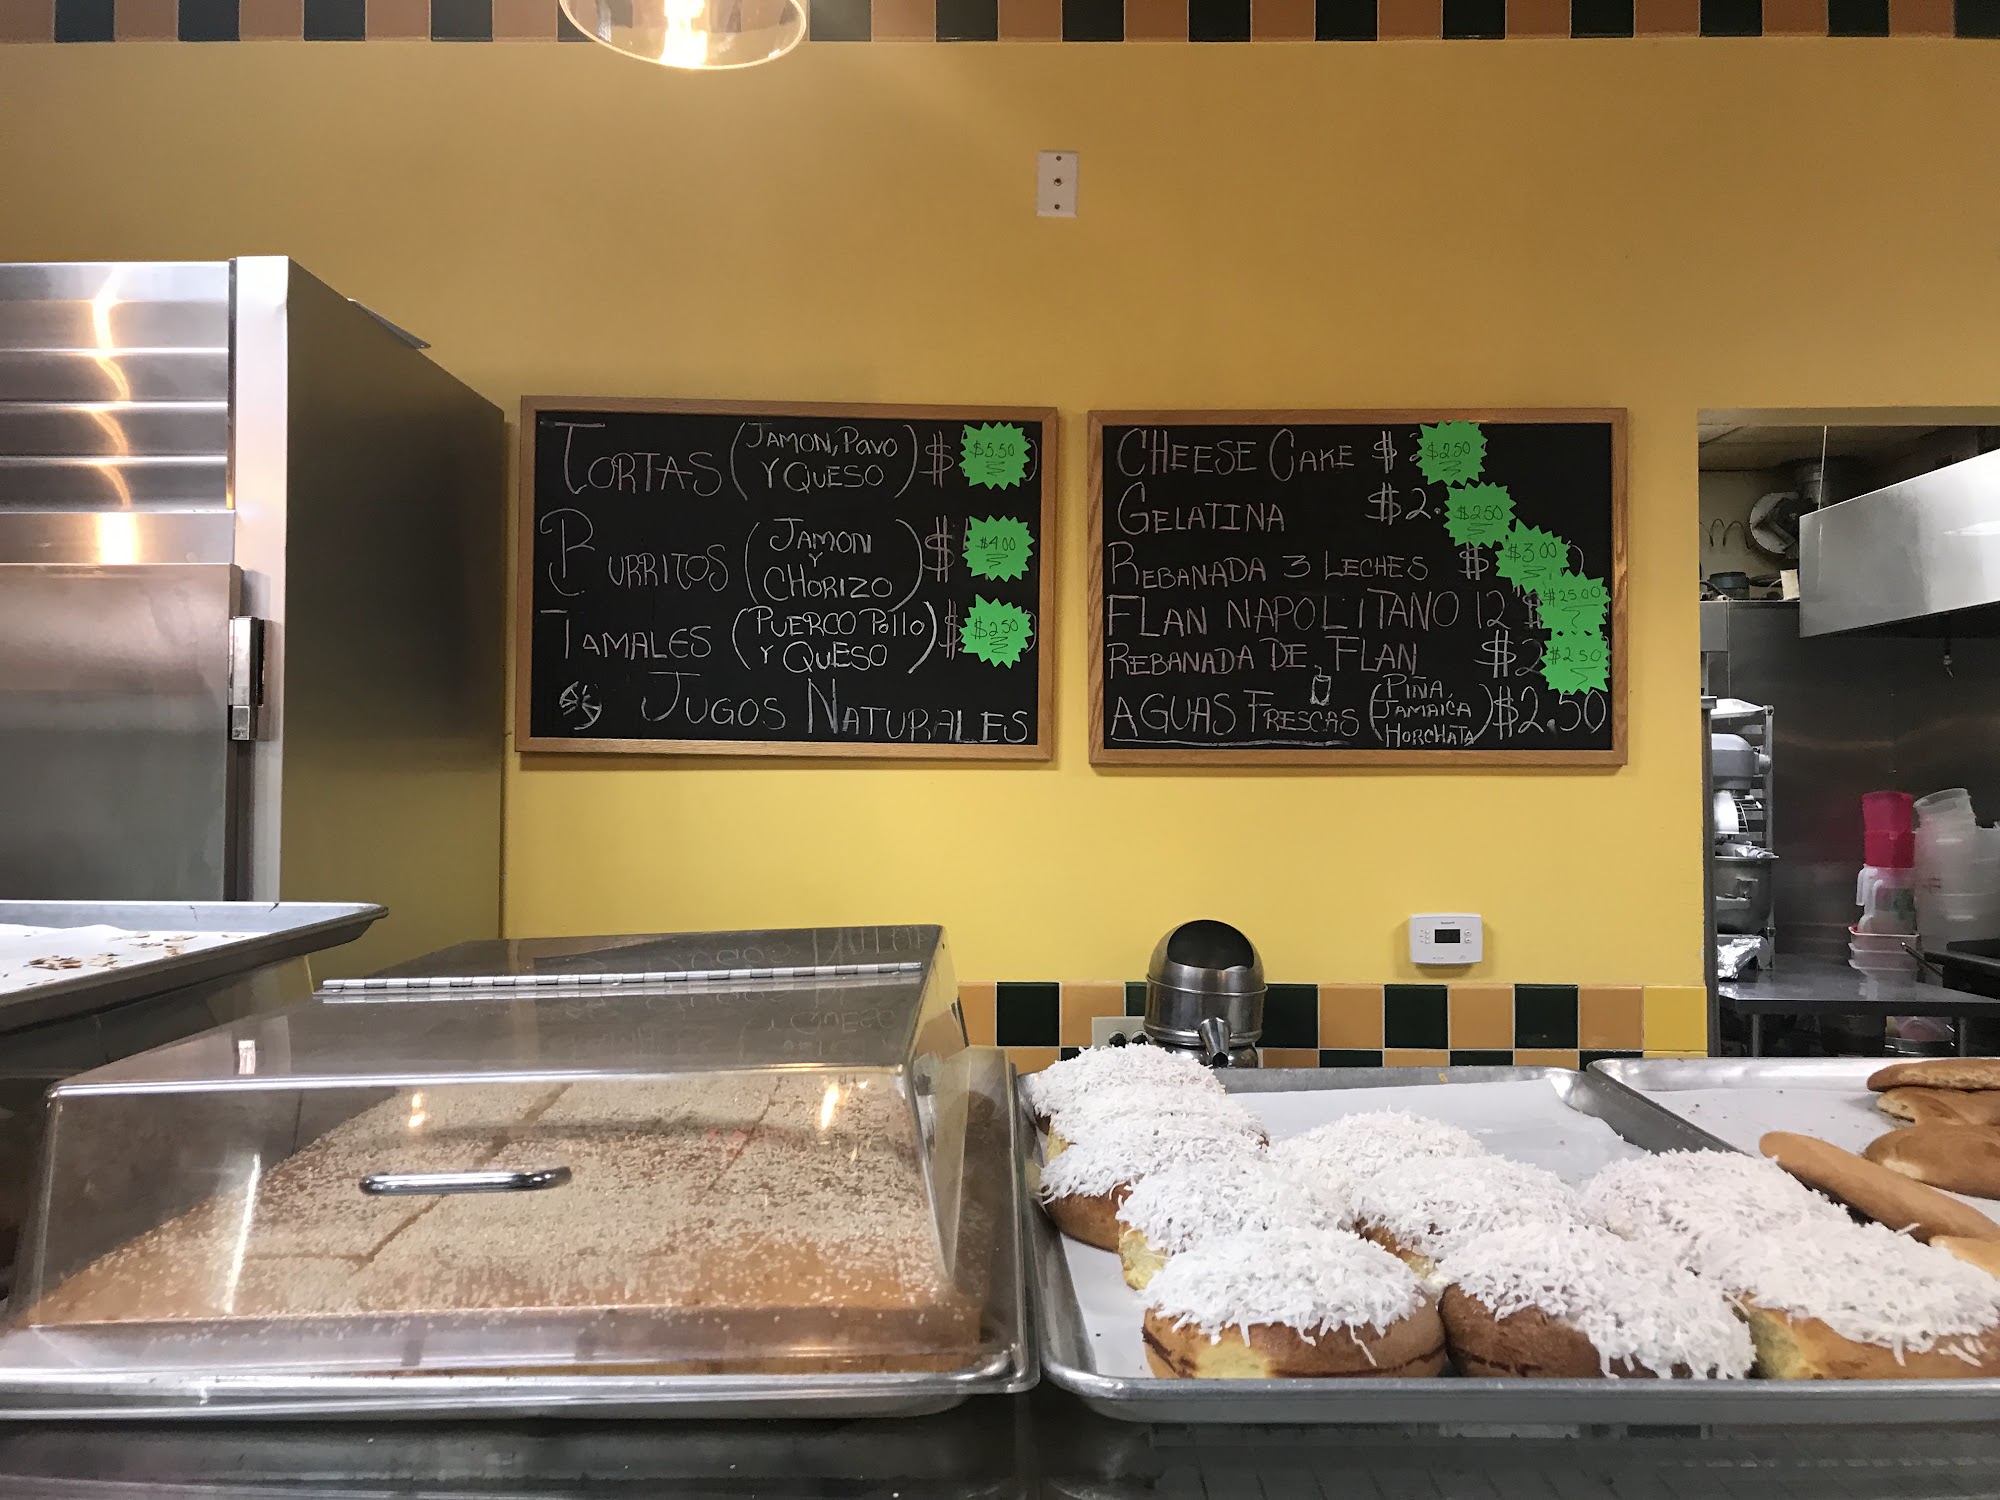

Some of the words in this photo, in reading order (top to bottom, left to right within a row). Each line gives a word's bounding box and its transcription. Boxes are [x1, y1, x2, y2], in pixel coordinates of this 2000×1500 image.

[540, 421, 722, 497] TORTAS
[969, 440, 1015, 459] $5.50
[1117, 427, 1257, 477] CHEESE
[1269, 428, 1355, 482] CAKE
[760, 457, 780, 489] Y
[783, 461, 885, 494] QUESO
[1117, 481, 1285, 536] GELATINA
[769, 517, 872, 554] JAMON
[763, 563, 893, 601] CHORIZO
[1107, 541, 1267, 590] REBANADA
[1282, 554, 1311, 578] 3
[1324, 550, 1429, 581] LECHES
[540, 609, 713, 661] TAMALES
[1106, 594, 1208, 638] FLAN
[1227, 588, 1459, 634] NAPOLITANO
[783, 640, 888, 674] QUESO
[1106, 642, 1255, 680] REBANADA
[1259, 638, 1307, 671] DE
[1325, 636, 1418, 676] FLAN
[640, 671, 787, 731] JUGOS
[807, 678, 1029, 744] NATURALES
[1110, 693, 1237, 738] AGUAS
[1243, 689, 1360, 738] FRESCAS
